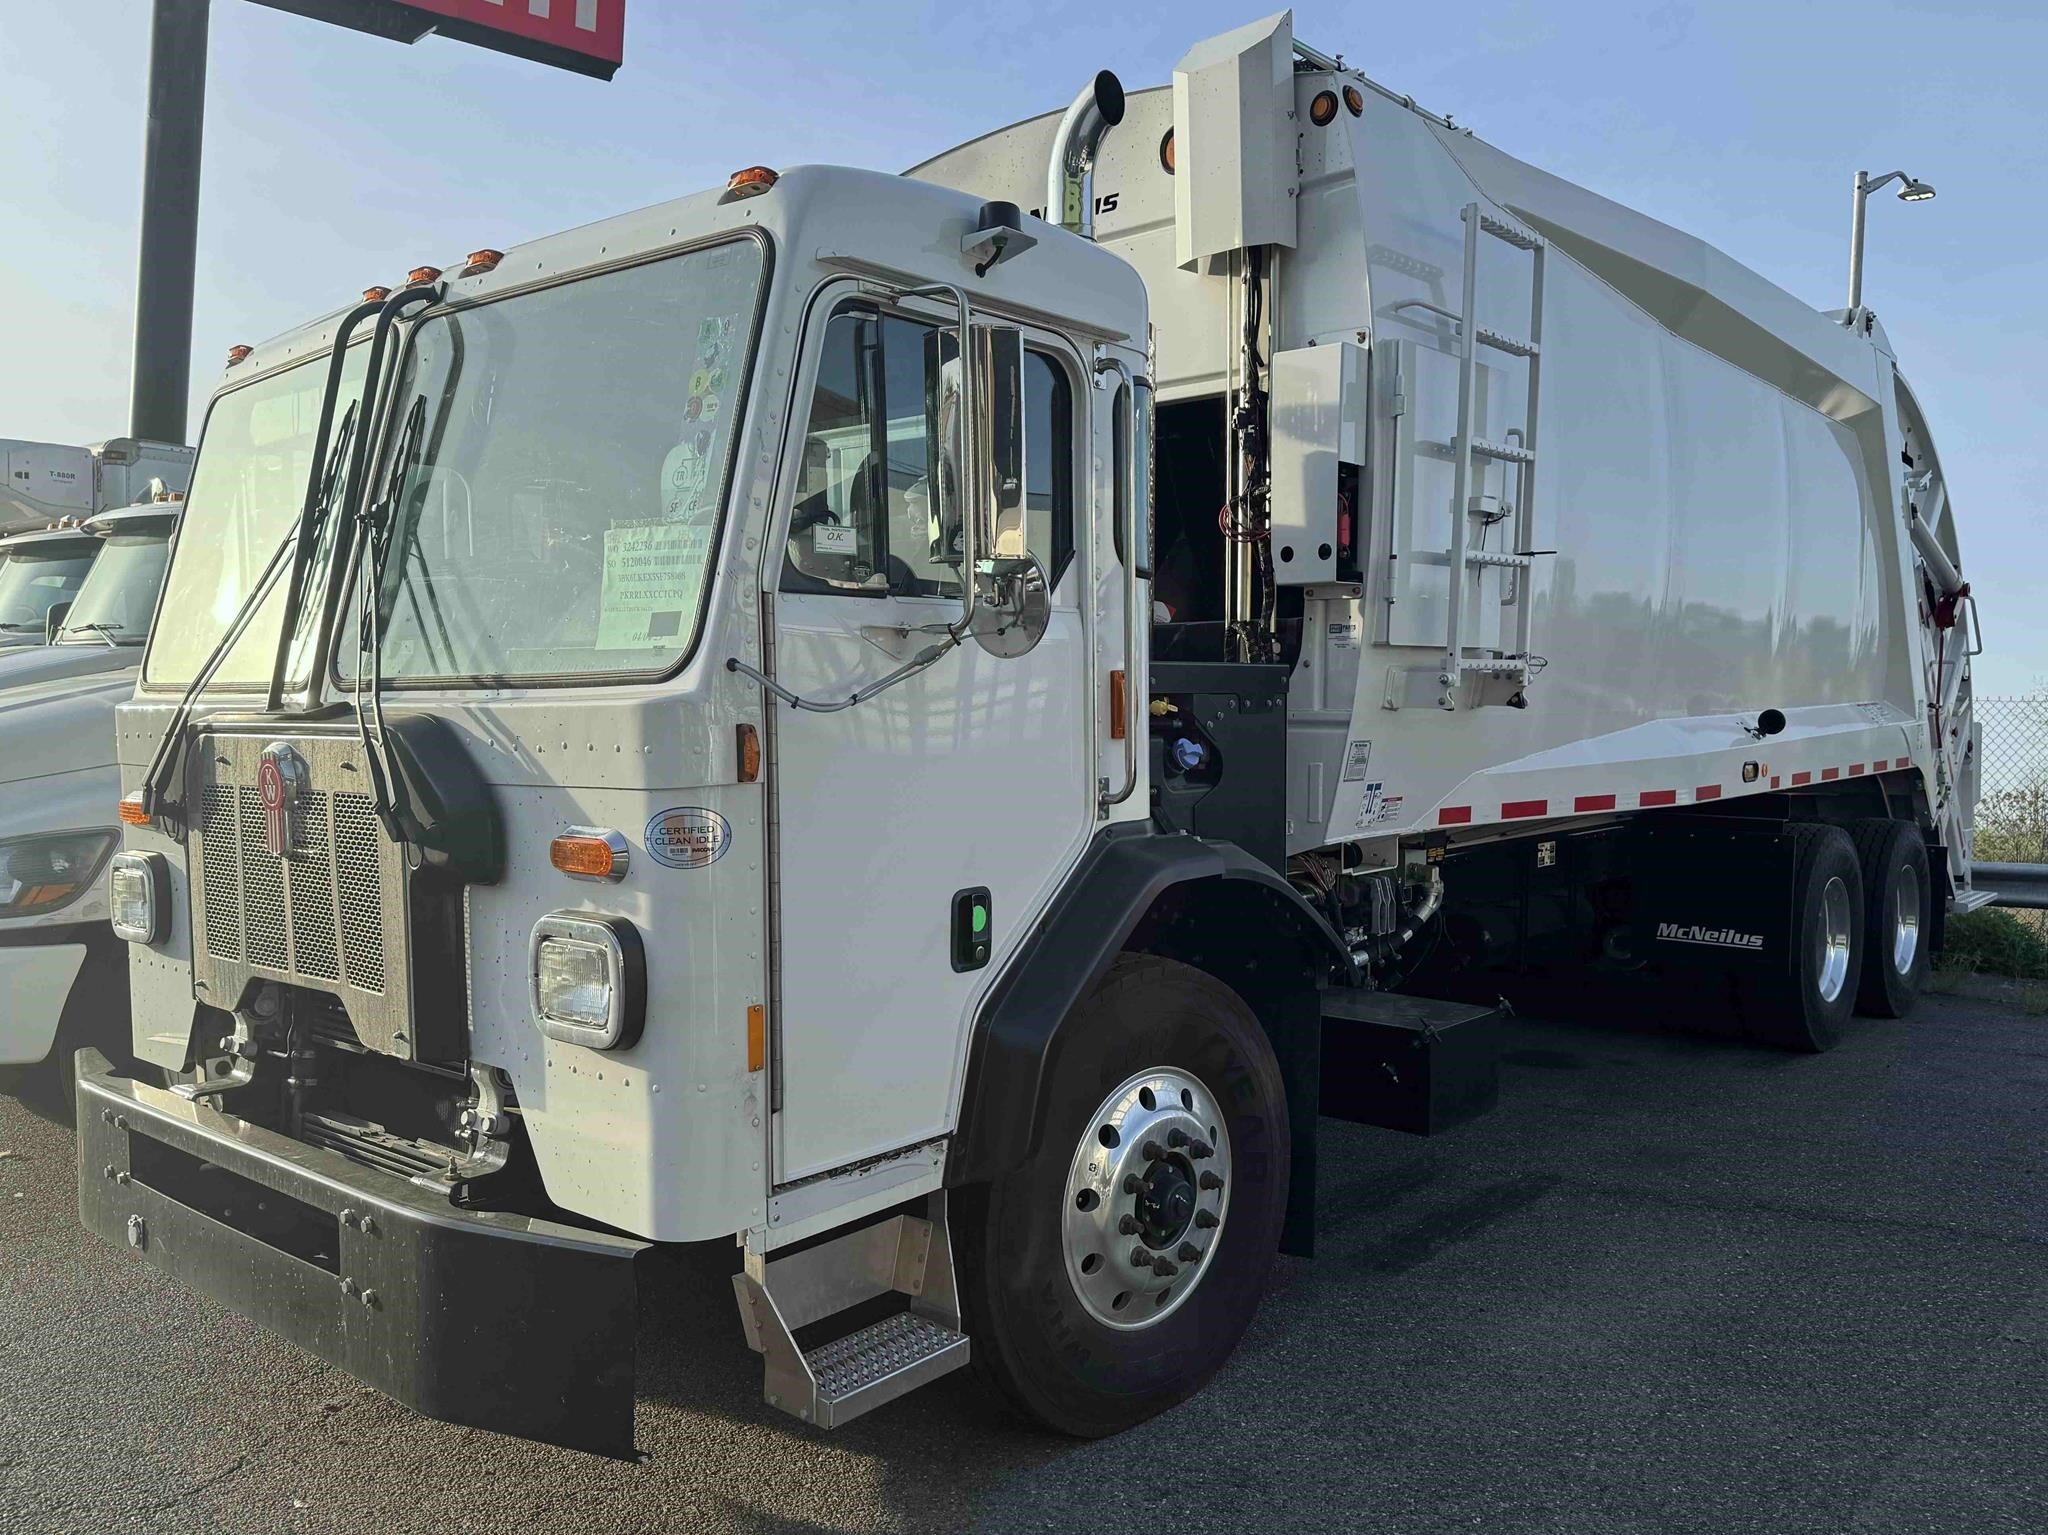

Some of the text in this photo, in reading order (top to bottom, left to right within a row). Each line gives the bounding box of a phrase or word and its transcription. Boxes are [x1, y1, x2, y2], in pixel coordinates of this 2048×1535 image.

[659, 826, 715, 835] CERTIFIED
[655, 835, 720, 846] CLEAN IDLE
[1656, 922, 1764, 948] McNeilus
